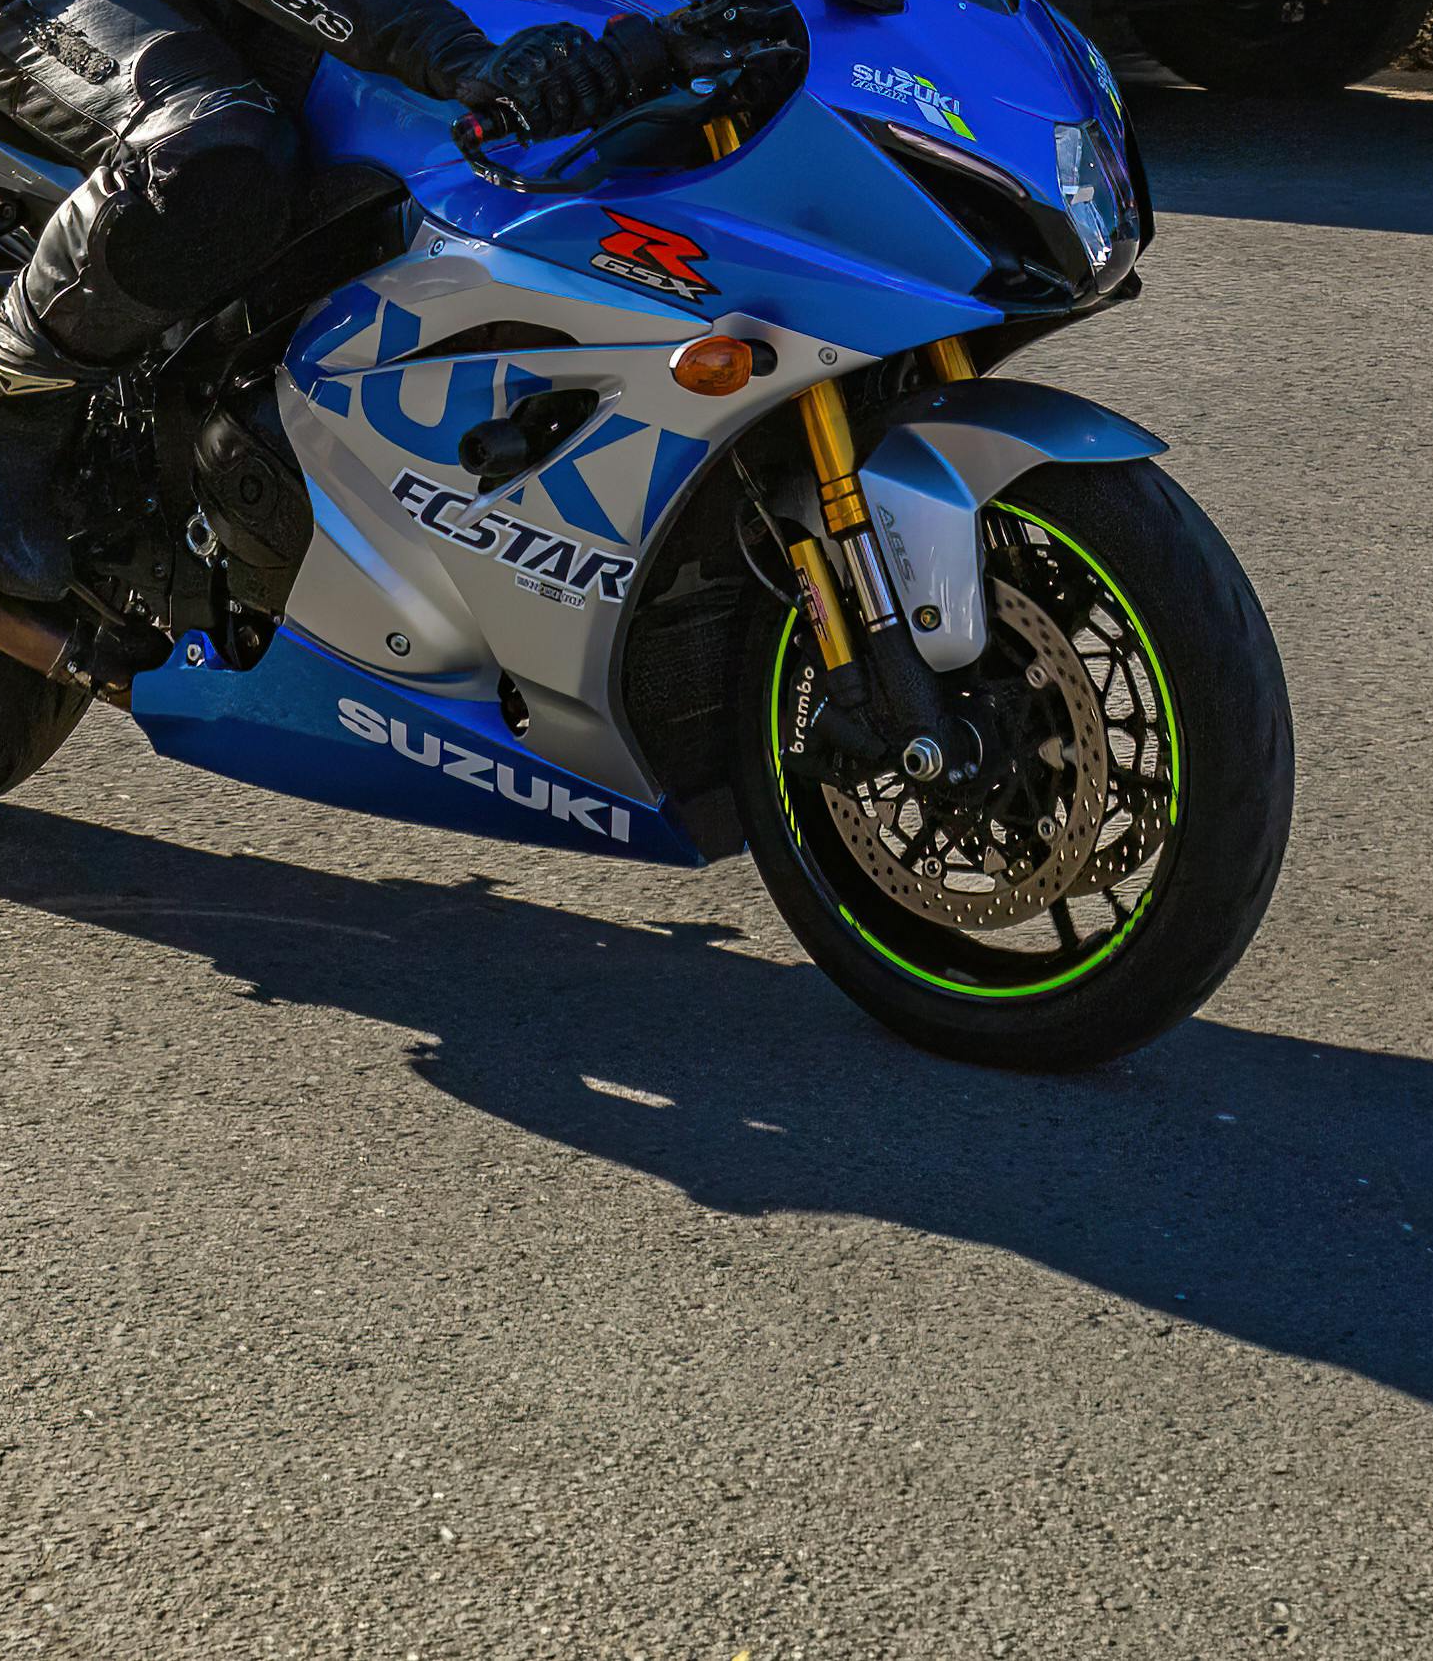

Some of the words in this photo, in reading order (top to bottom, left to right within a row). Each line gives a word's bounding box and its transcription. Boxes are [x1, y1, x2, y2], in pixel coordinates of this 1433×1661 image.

[852, 64, 960, 116] SUZUKI
[591, 252, 708, 300] GSX
[390, 469, 638, 602] ECSTAR
[790, 665, 815, 754] brembo
[337, 698, 630, 843] SUZUKI
